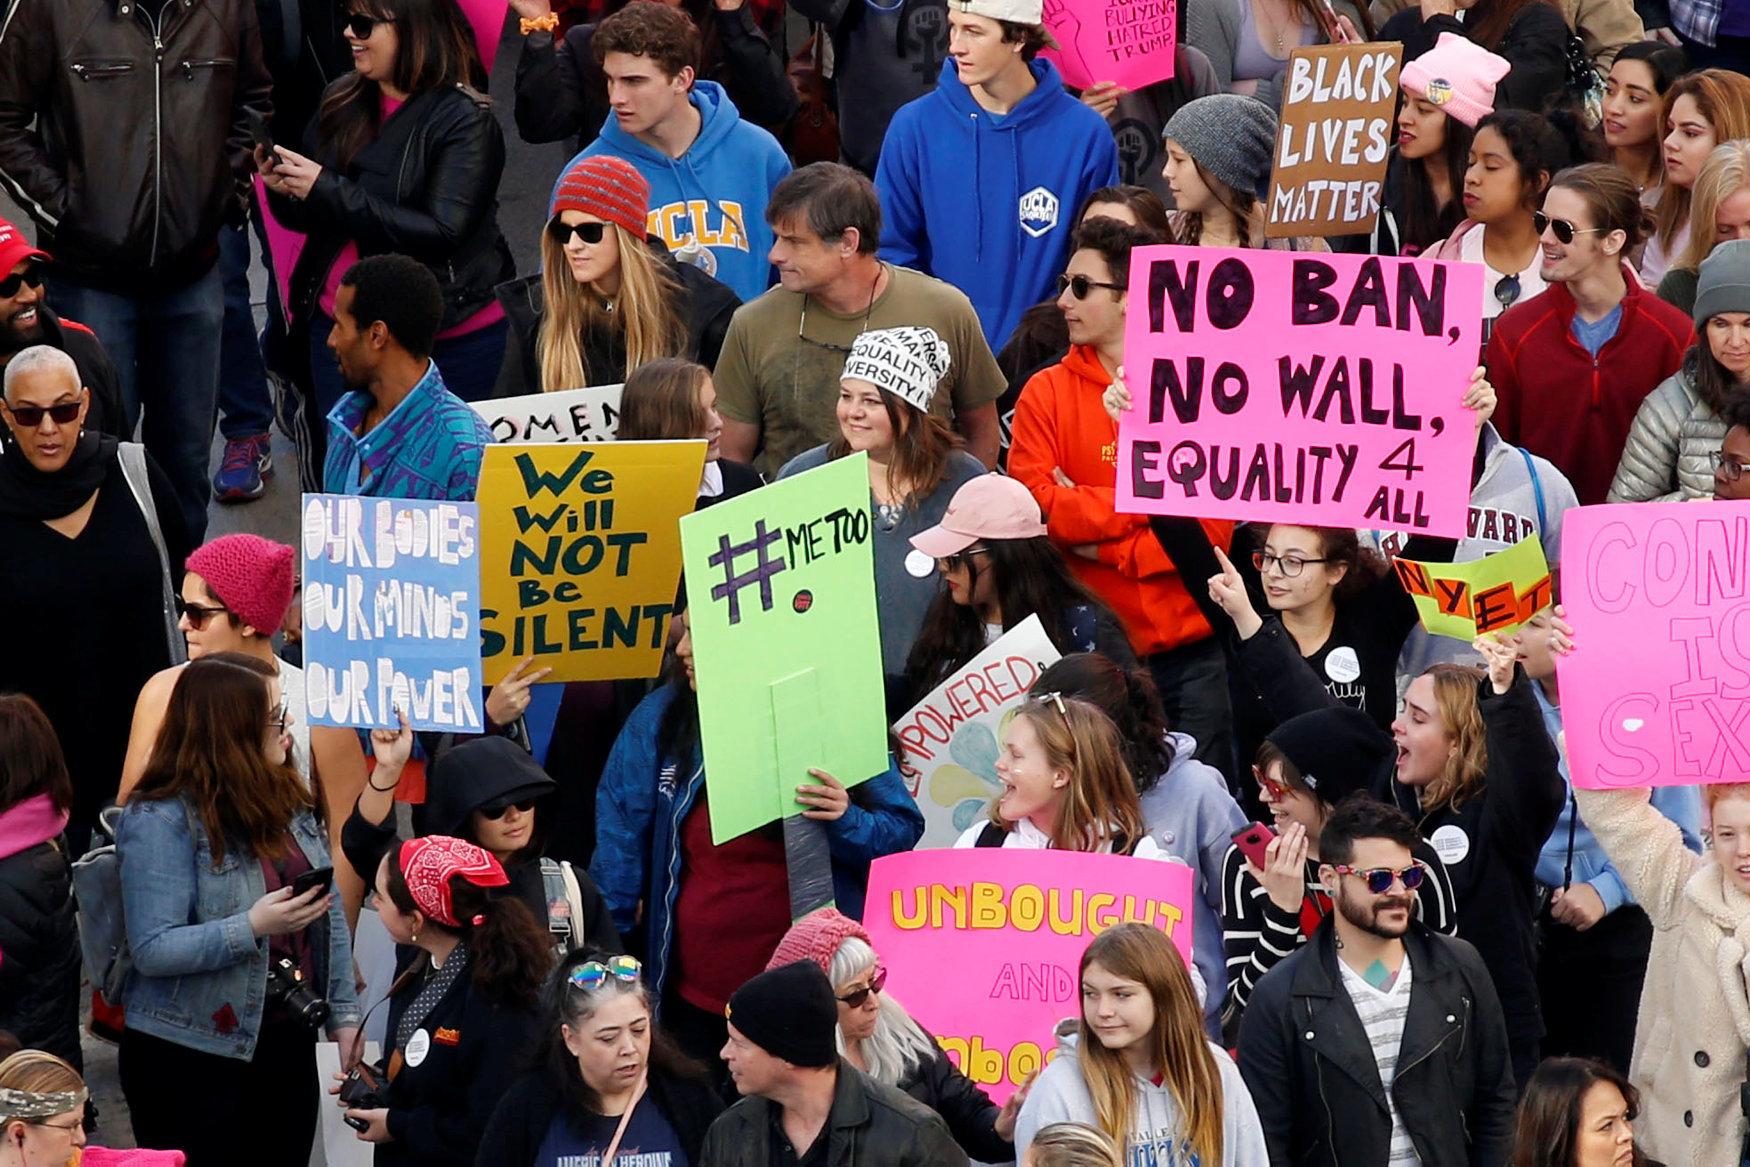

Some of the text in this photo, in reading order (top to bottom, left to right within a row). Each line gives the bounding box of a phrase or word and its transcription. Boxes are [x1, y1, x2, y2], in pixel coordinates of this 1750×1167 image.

[1107, 17, 1172, 46] HATRED
[1287, 51, 1396, 106] BLACK
[1278, 116, 1389, 169] LIVES
[1269, 179, 1382, 224] MATTER
[1148, 256, 1462, 346] NO BAN,
[487, 402, 621, 441] OMEN
[1148, 354, 1445, 437] NO WALL,
[513, 450, 615, 499] We
[1131, 437, 1424, 504] EQUALITY 4
[303, 497, 475, 569] OUR BODIES
[1363, 484, 1430, 528] ALL
[509, 532, 648, 577] NOT
[303, 574, 469, 641] OUR MINDS
[518, 580, 583, 610] Be
[1395, 559, 1551, 631] NYET
[480, 604, 674, 658] SILENT
[305, 656, 481, 728] OUR POWER
[891, 882, 1184, 937] UNBOUGHT
[989, 961, 1074, 1004] AND
